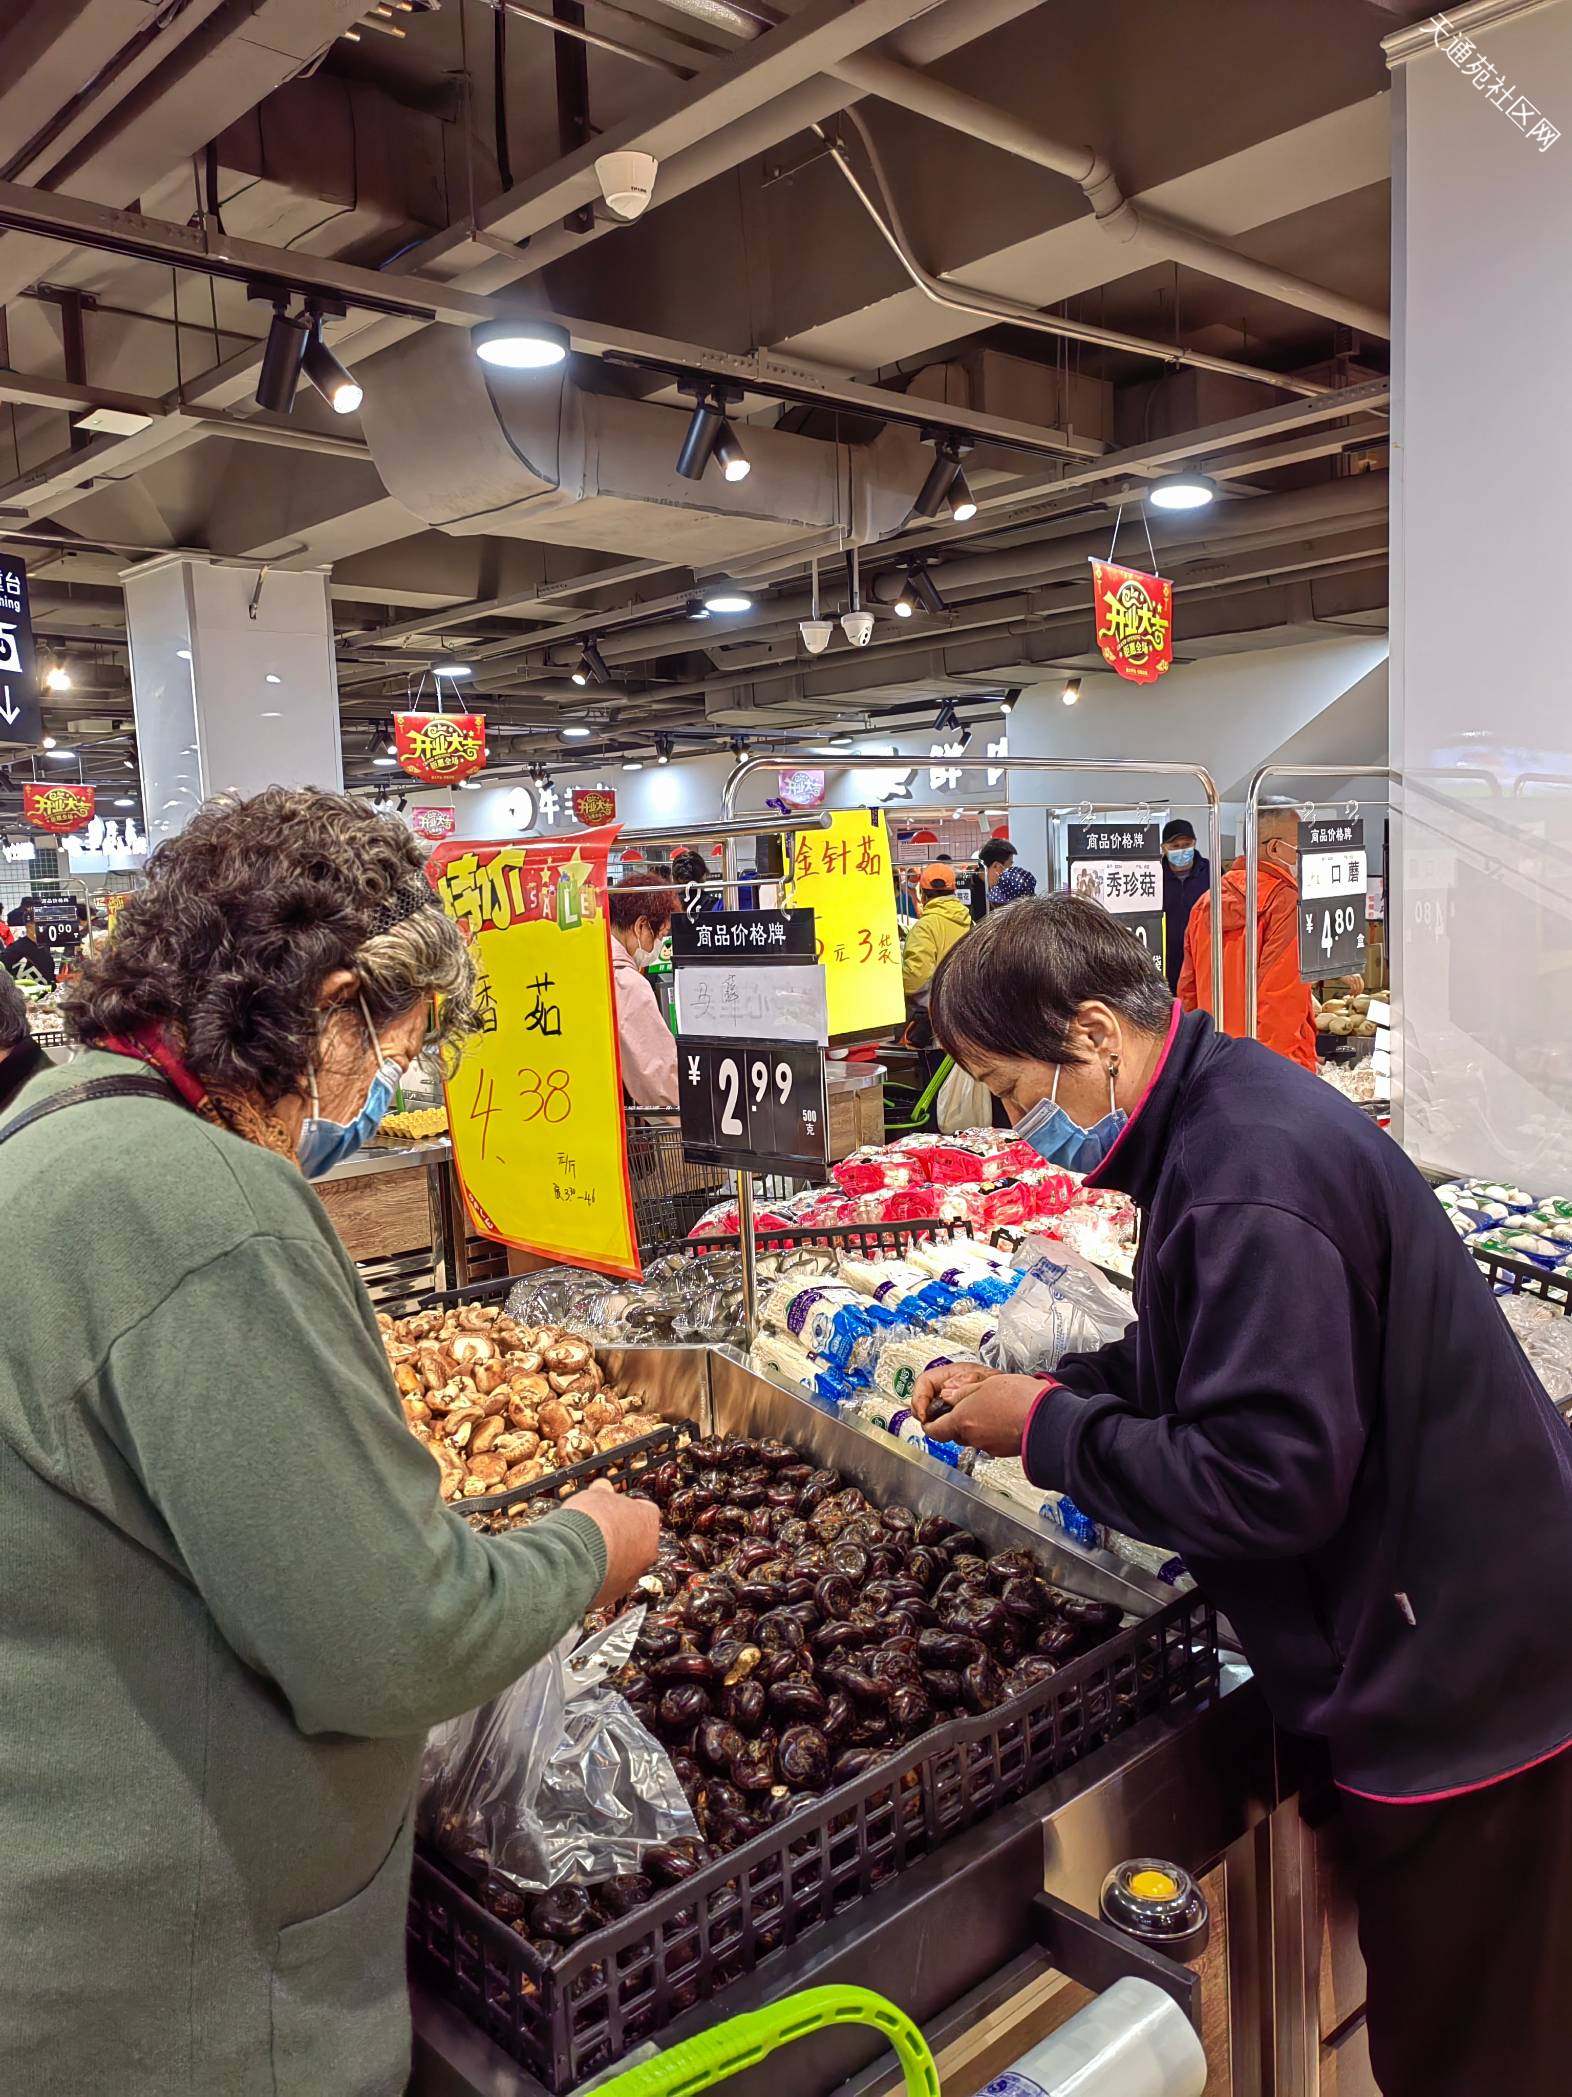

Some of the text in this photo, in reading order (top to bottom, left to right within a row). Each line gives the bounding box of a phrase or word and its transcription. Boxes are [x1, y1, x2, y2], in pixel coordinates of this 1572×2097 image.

[1100, 590, 1169, 651] 开业大吉
[401, 730, 482, 762] 开业大吉
[1086, 832, 1145, 850] 商品价格牌
[1310, 827, 1353, 844] 商品价格牌
[438, 845, 527, 932] 特价
[1106, 871, 1156, 898] 秀珍菇
[529, 886, 592, 924] SALE
[695, 922, 787, 948] 商品价格牌
[1321, 906, 1355, 958] 4.80
[1356, 932, 1366, 949] 盒
[687, 1055, 793, 1136] ¥ 2.99
[802, 1109, 817, 1123] 500
[805, 1123, 816, 1136] 克
